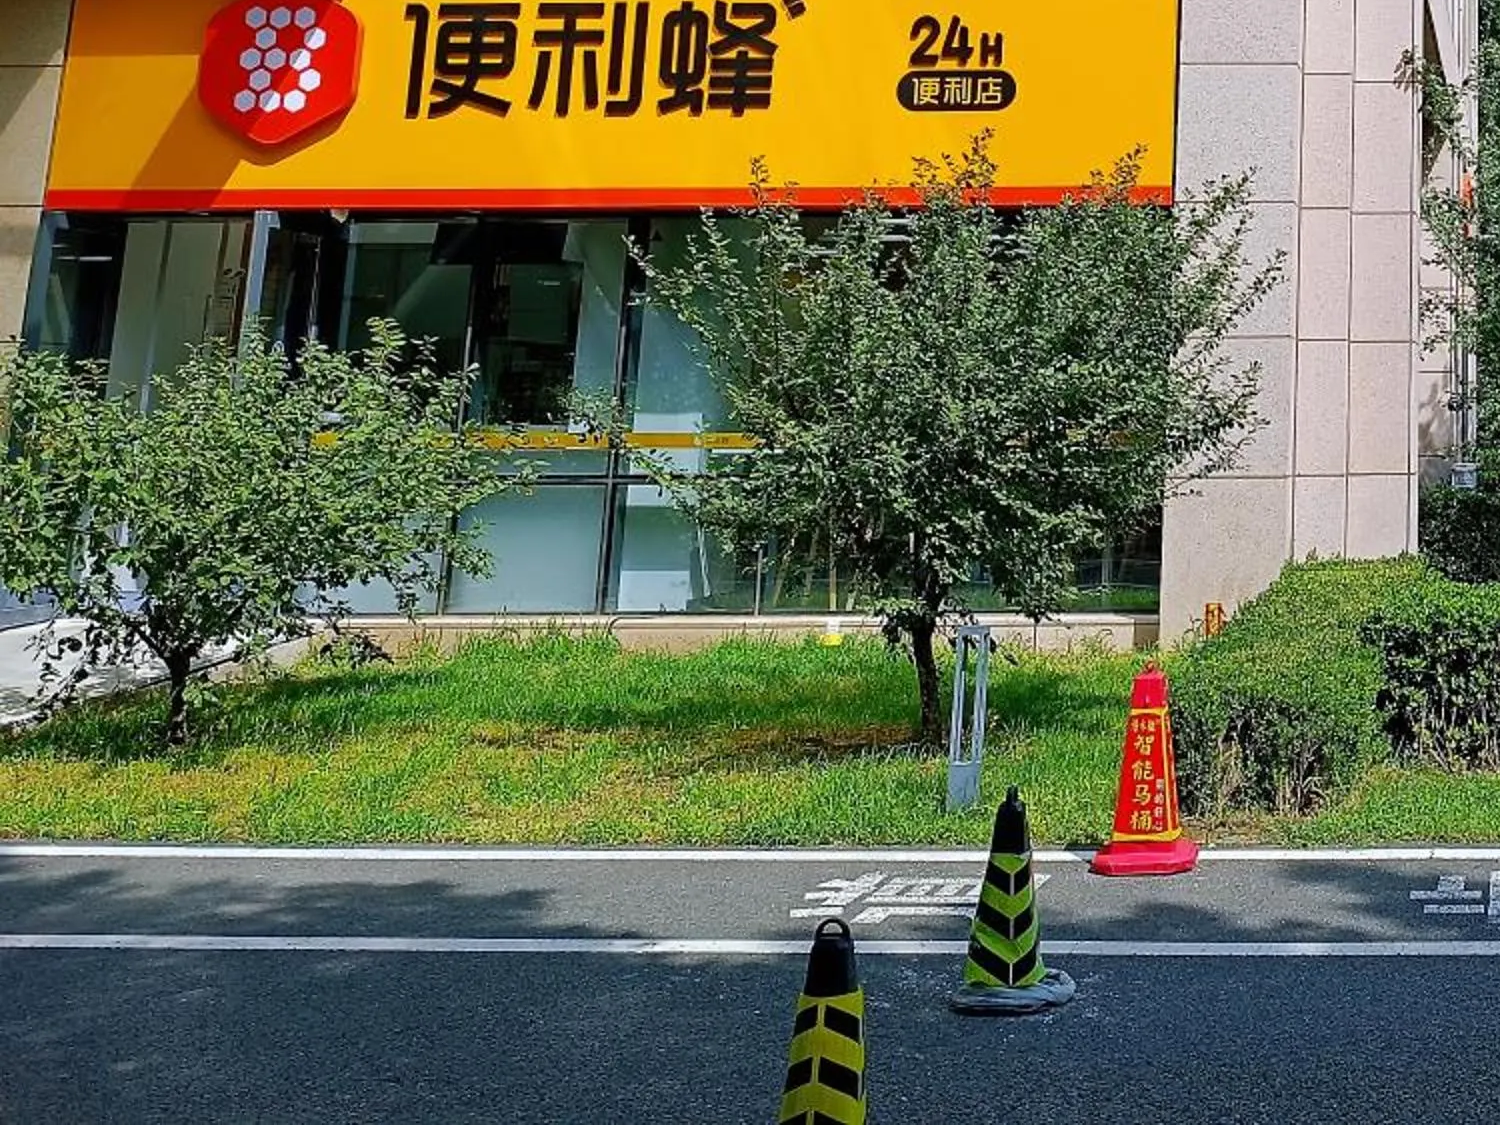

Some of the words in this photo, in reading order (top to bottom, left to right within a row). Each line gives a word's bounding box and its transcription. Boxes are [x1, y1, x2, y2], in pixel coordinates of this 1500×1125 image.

[403, 0, 780, 119] 便利蜂
[908, 14, 1004, 68] 24H
[911, 77, 1003, 105] 便利店
[1130, 734, 1155, 831] 智能马桶
